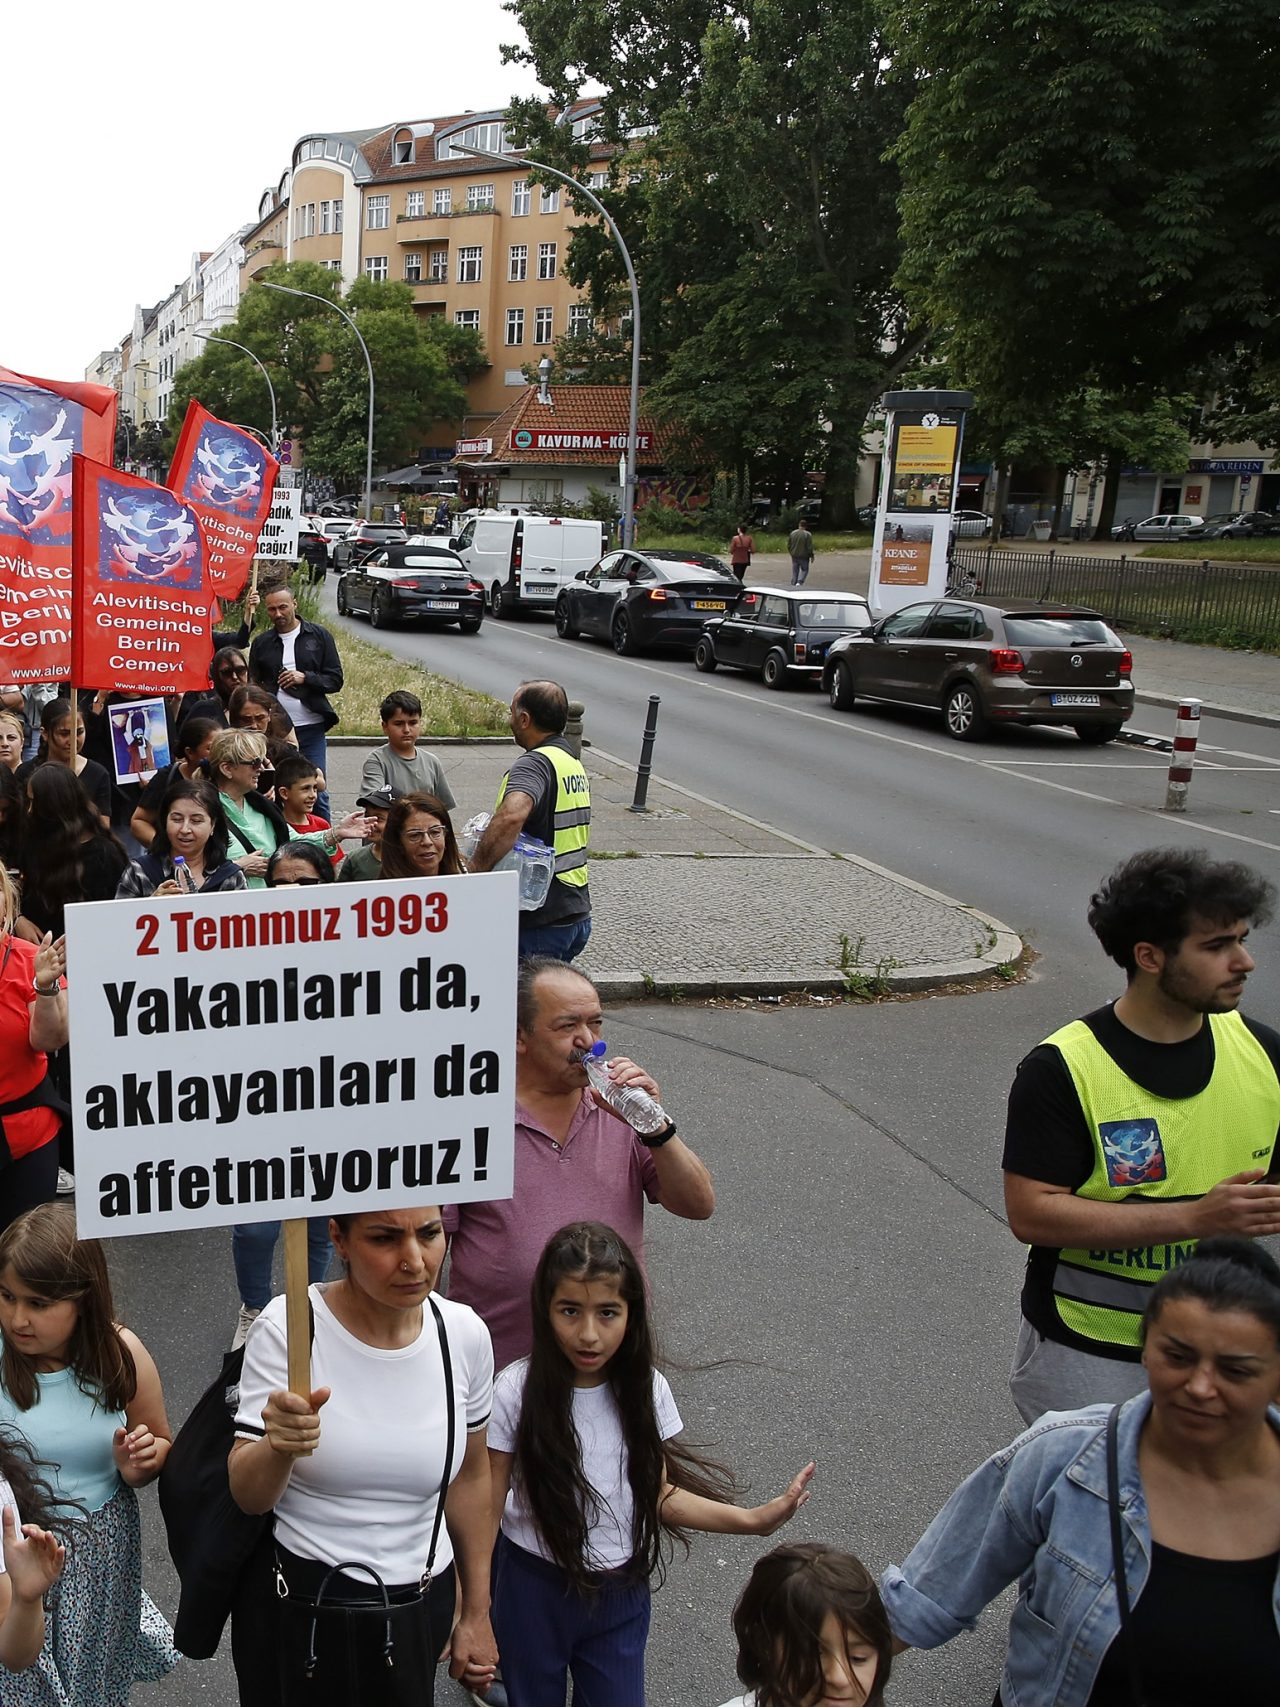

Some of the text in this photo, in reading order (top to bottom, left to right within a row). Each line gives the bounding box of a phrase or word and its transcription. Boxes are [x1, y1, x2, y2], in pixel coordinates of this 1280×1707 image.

[537, 432, 649, 449] KAVURMA-KÖTE
[1227, 462, 1260, 470] REISEN
[274, 491, 290, 500] 1993
[885, 549, 918, 559] KEANE
[93, 592, 208, 617] Alevitische
[96, 612, 204, 635] Gemeinde
[117, 636, 181, 653] Berlin
[109, 655, 184, 673] Cemevi
[115, 681, 176, 693] www.alevi.org
[136, 891, 449, 956] 2 Temmuz 1993
[103, 957, 481, 1037] Yakanları da,
[85, 1044, 500, 1131] aklayanları da
[99, 1139, 461, 1218] affetmiyoruz
